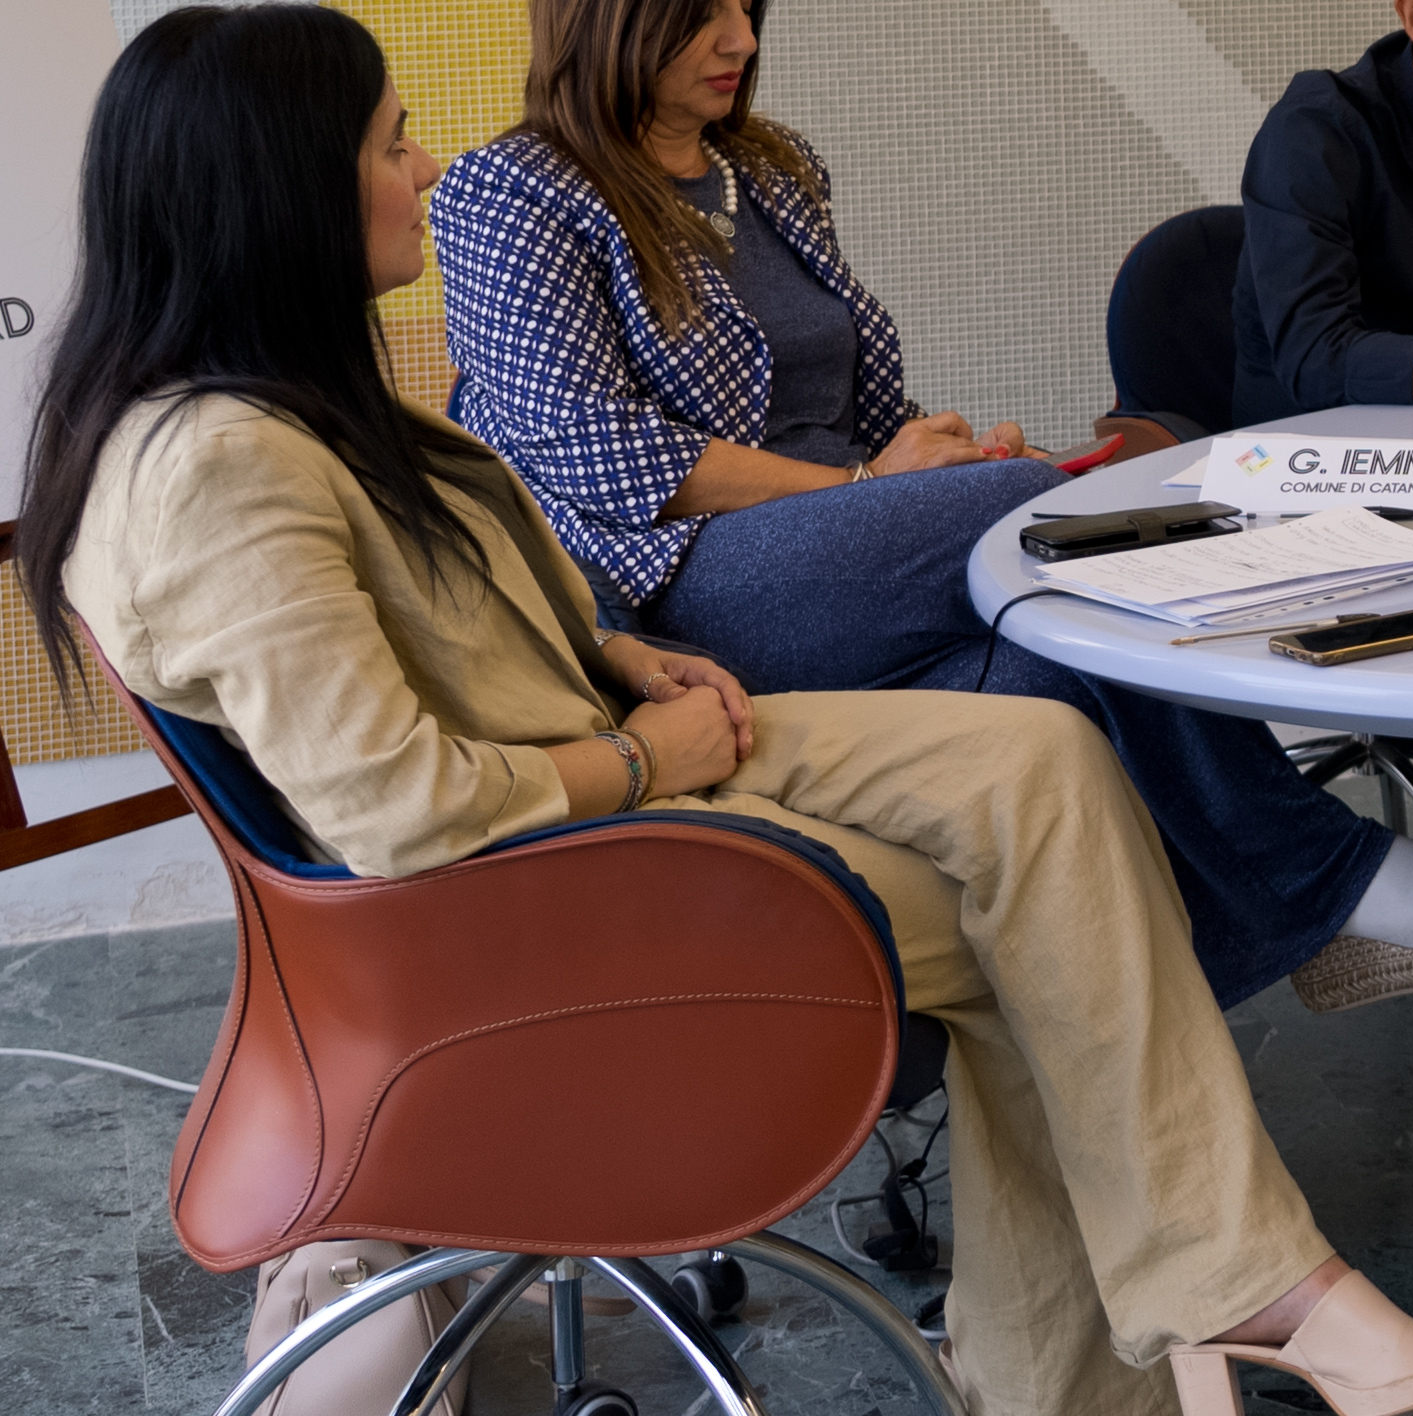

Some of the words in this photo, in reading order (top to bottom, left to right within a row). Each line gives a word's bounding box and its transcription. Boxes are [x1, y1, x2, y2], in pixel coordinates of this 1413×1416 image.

[1289, 449, 1327, 474] G.
[1280, 482, 1347, 493] COMUNE
[1351, 482, 1365, 493] DI
